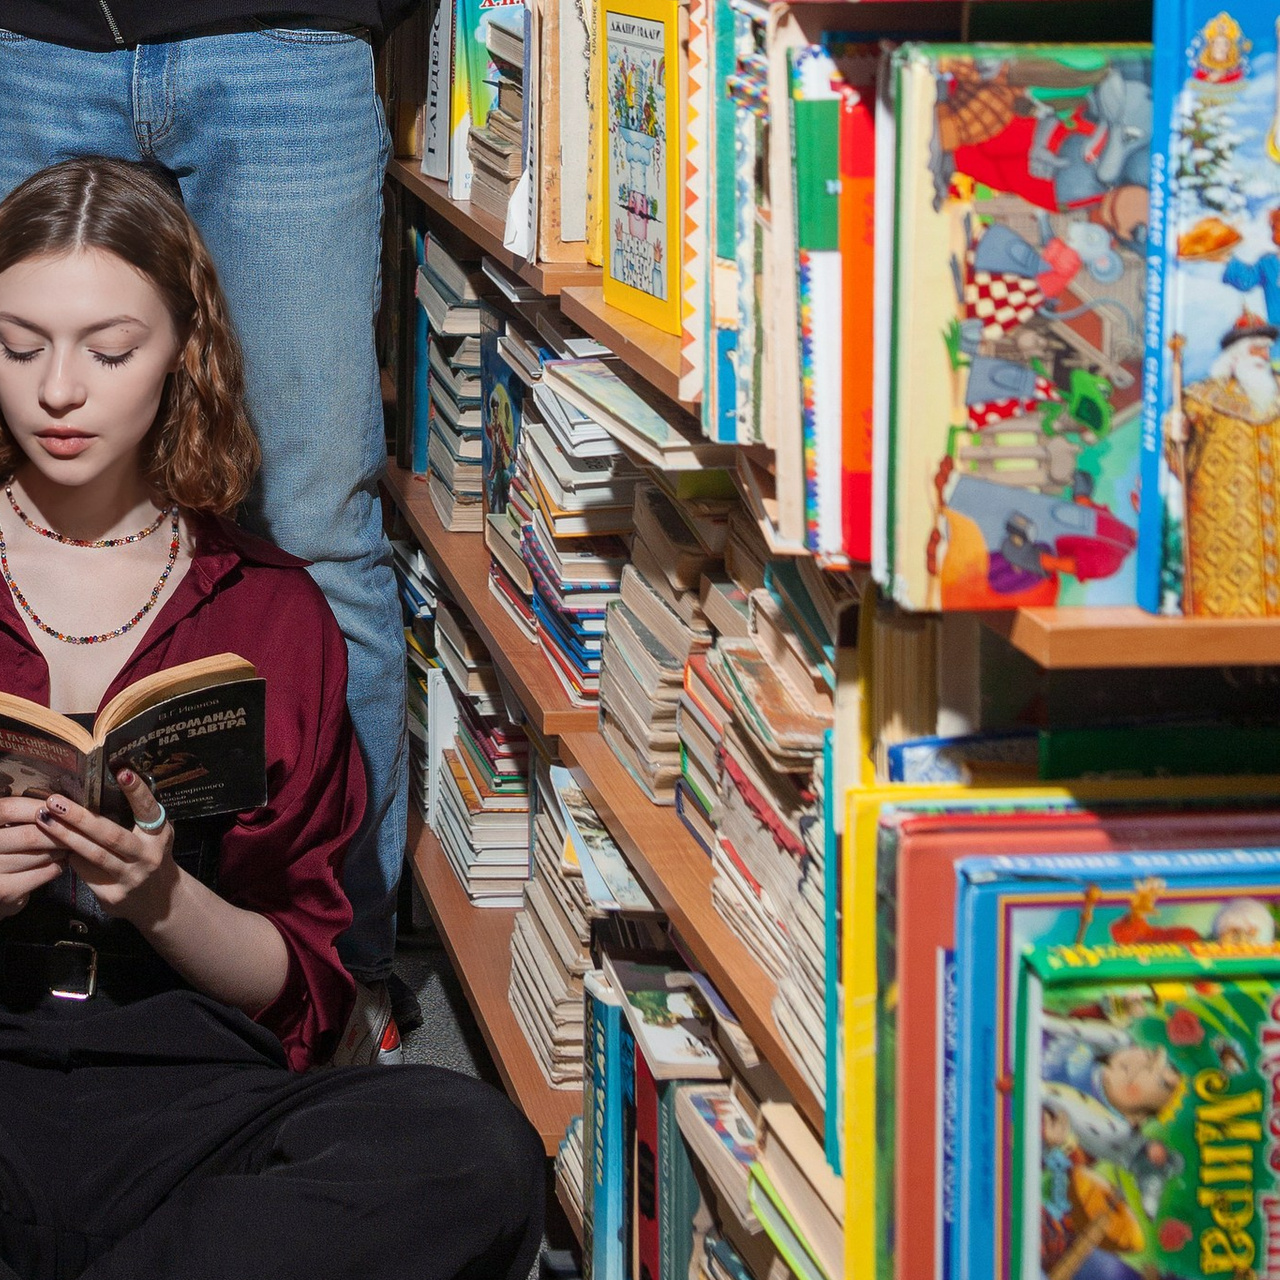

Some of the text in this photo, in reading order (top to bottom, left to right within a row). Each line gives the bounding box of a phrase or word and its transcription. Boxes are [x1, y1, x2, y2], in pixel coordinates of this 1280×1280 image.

[592, 5, 600, 56] АРАБСКИЕ
[6, 732, 70, 758] FASCHISMUS
[108, 706, 247, 762] ЗОНДЕРКОМАНДА
[158, 717, 247, 747] НА ЗАВТРА
[1193, 1069, 1263, 1276] Мира
